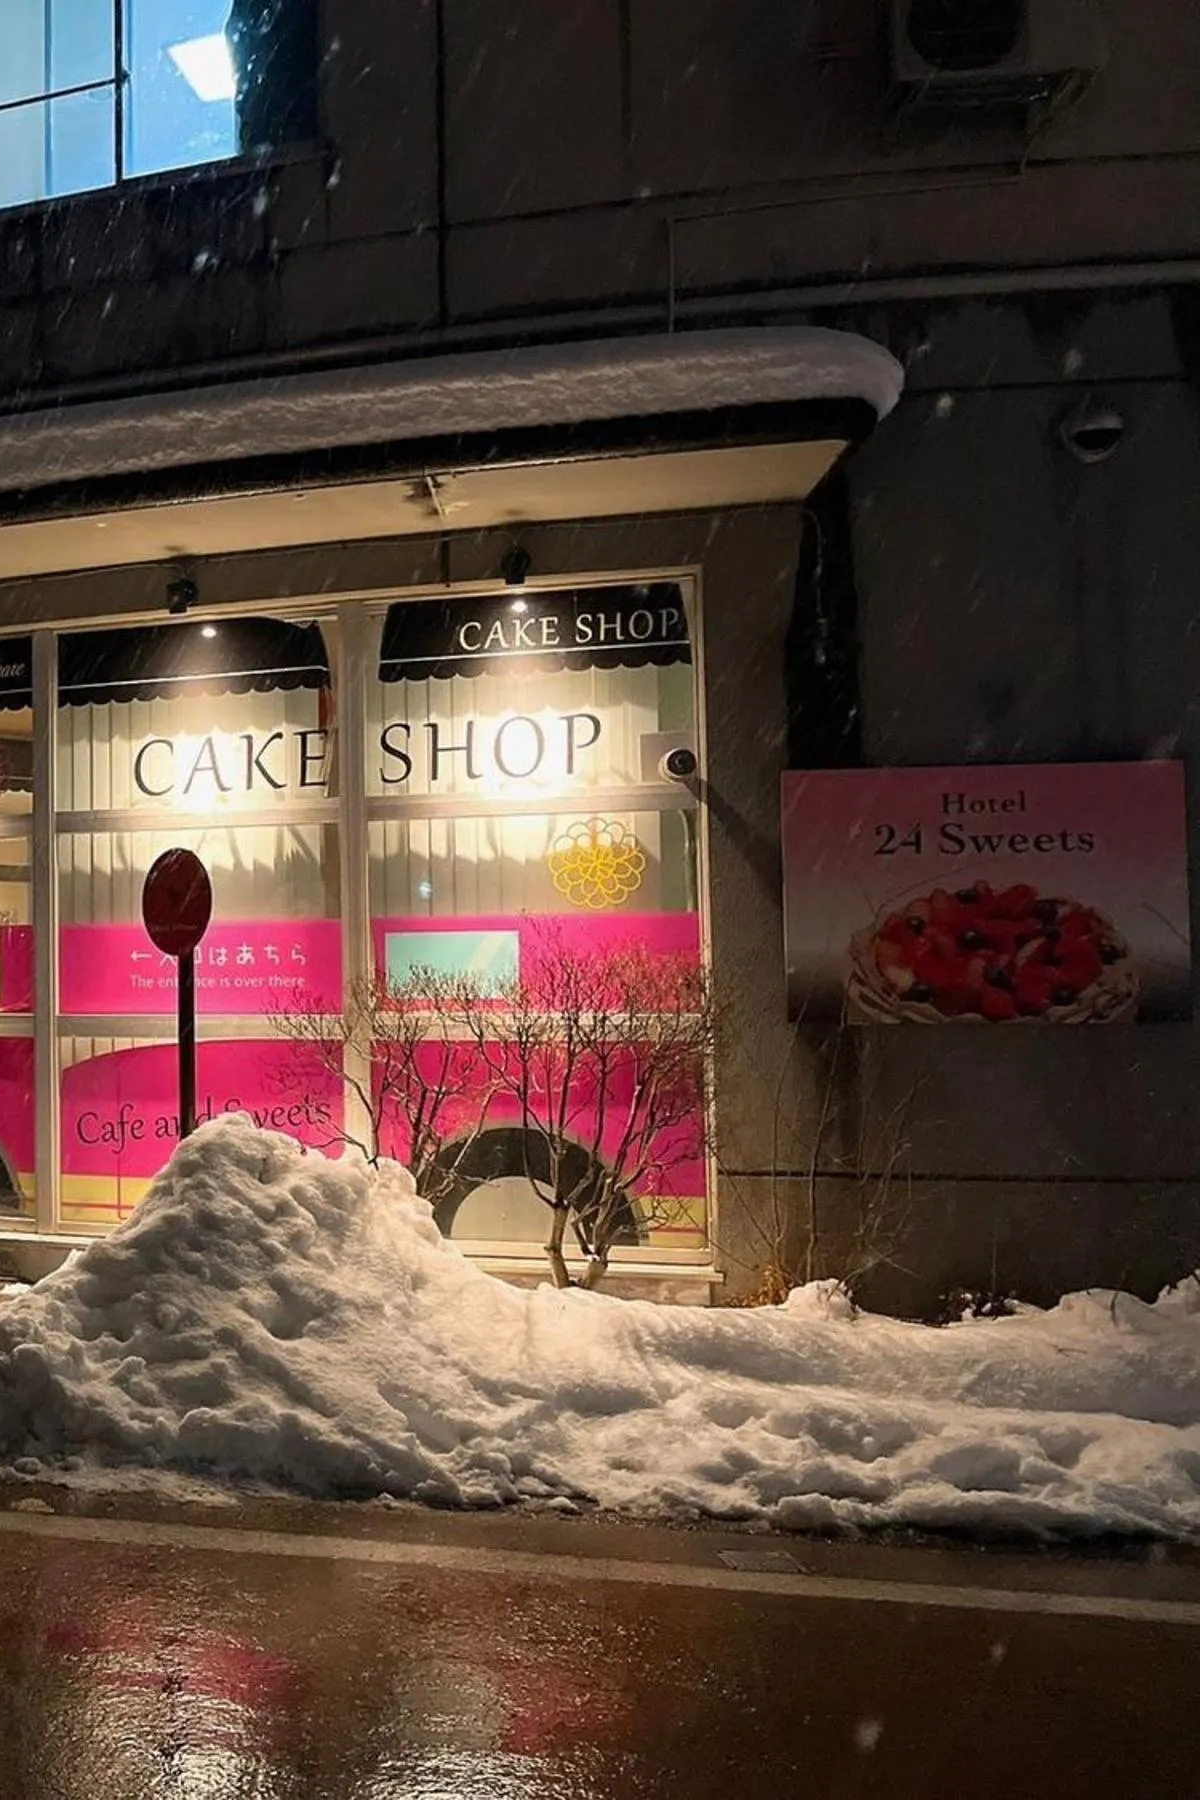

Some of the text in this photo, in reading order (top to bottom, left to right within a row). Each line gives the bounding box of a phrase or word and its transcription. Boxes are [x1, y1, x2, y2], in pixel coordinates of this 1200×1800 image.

[460, 607, 680, 653] CAKE SHOP
[134, 713, 602, 796] CAKE SHOP
[942, 790, 1027, 815] Hotel
[873, 821, 1096, 856] 24 Sweets
[130, 974, 152, 988] The
[219, 974, 231, 988] is
[234, 976, 265, 988] over
[268, 974, 306, 988] there
[77, 1103, 145, 1155] Cafe
